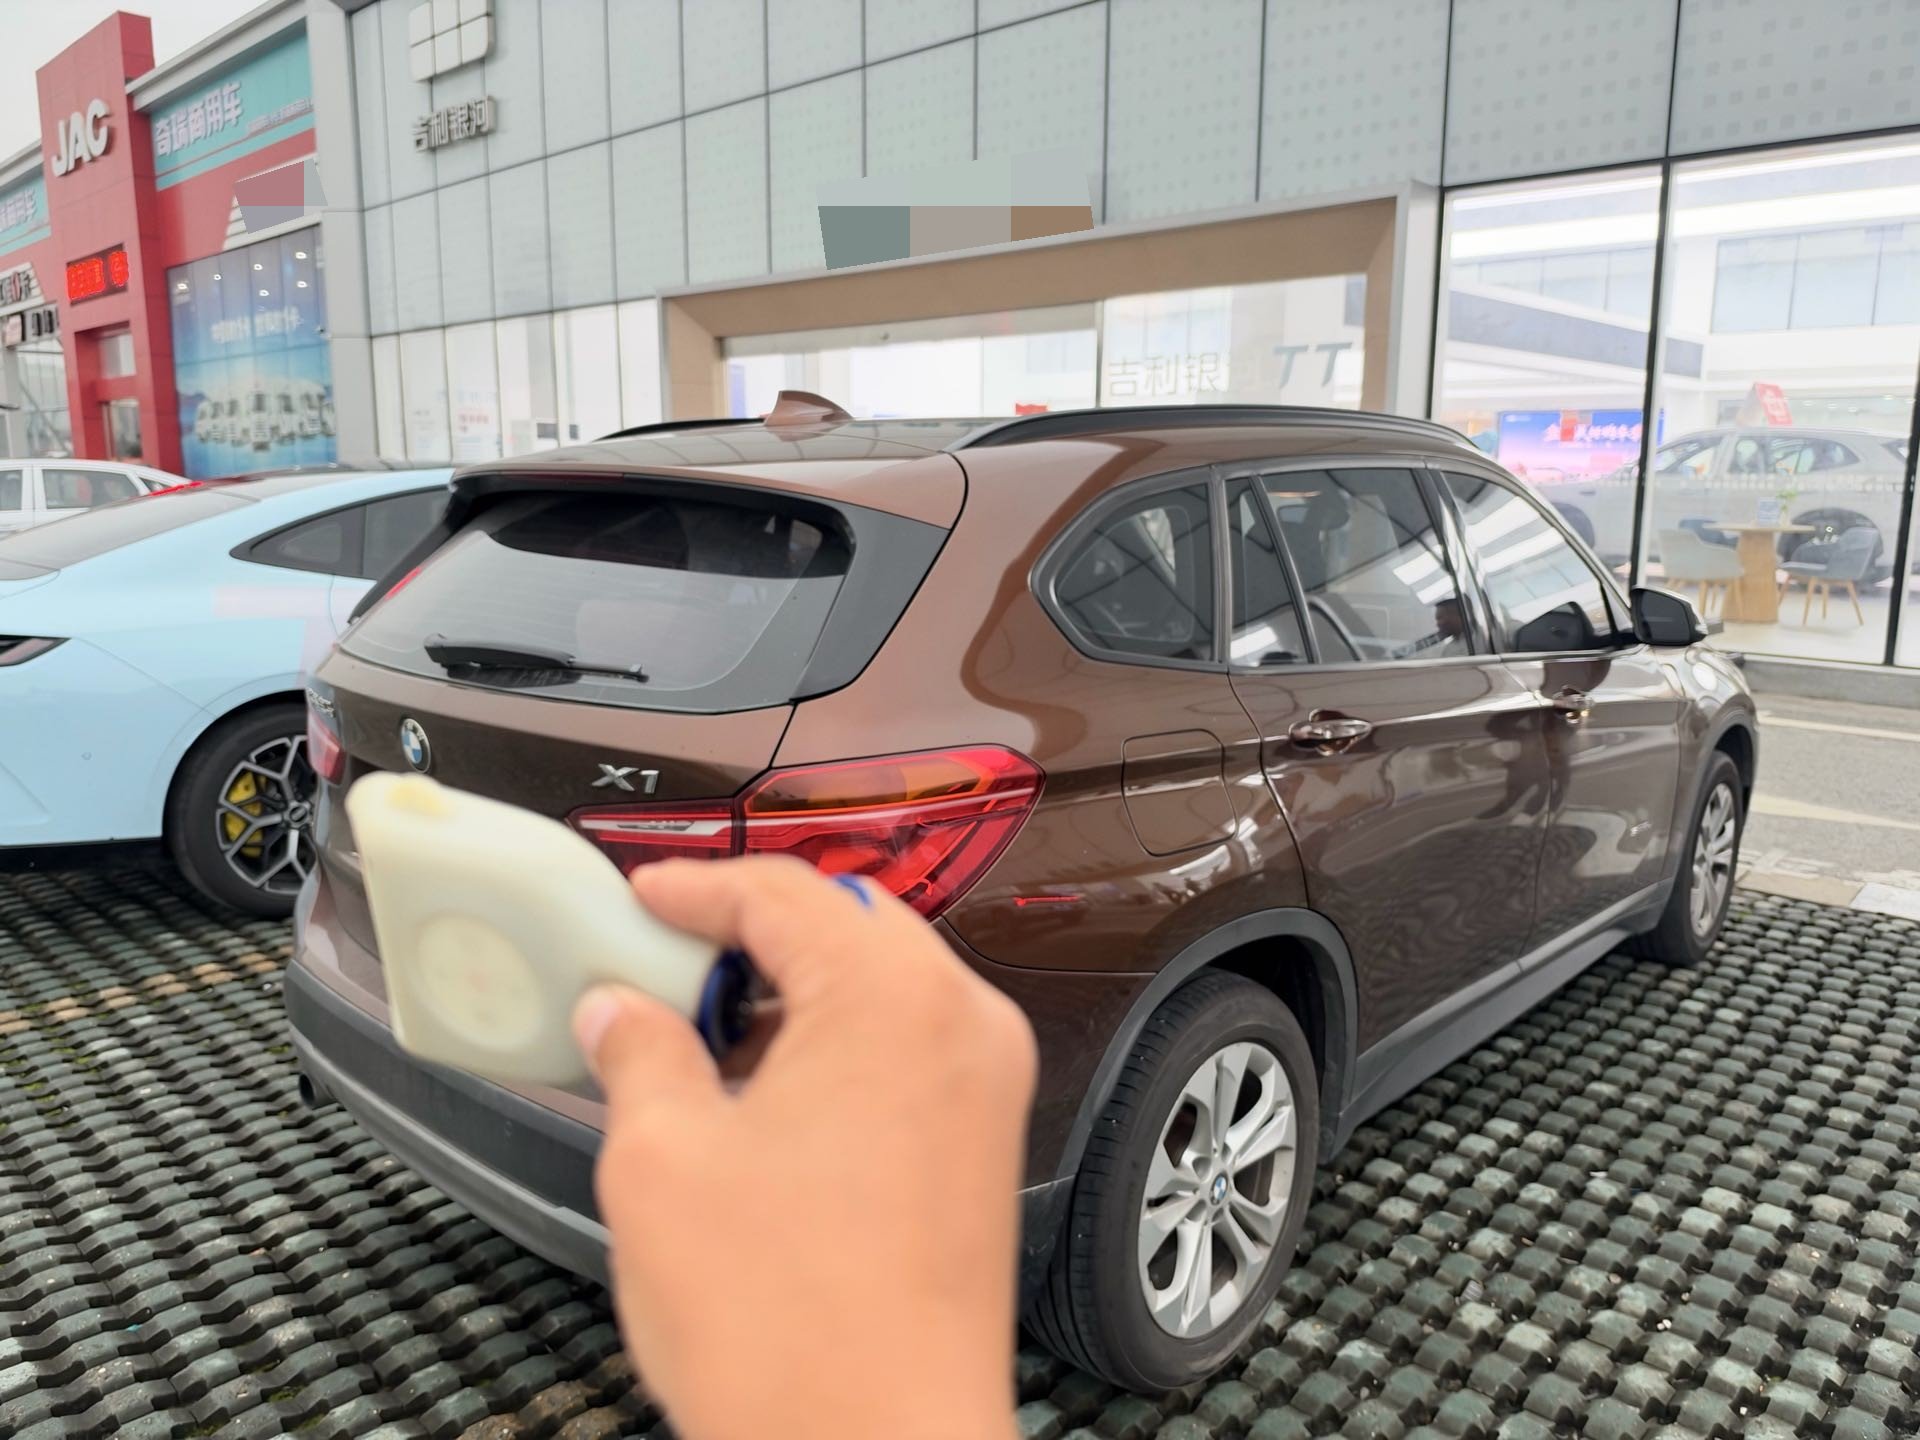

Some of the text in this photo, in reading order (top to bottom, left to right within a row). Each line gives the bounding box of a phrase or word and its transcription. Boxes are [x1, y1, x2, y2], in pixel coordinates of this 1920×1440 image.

[51, 98, 110, 177] JAC
[154, 80, 243, 156] 奇瑞商用车
[411, 96, 493, 151] 吉利银河
[1108, 352, 1258, 398] 吉利银
[591, 763, 660, 794] X1
